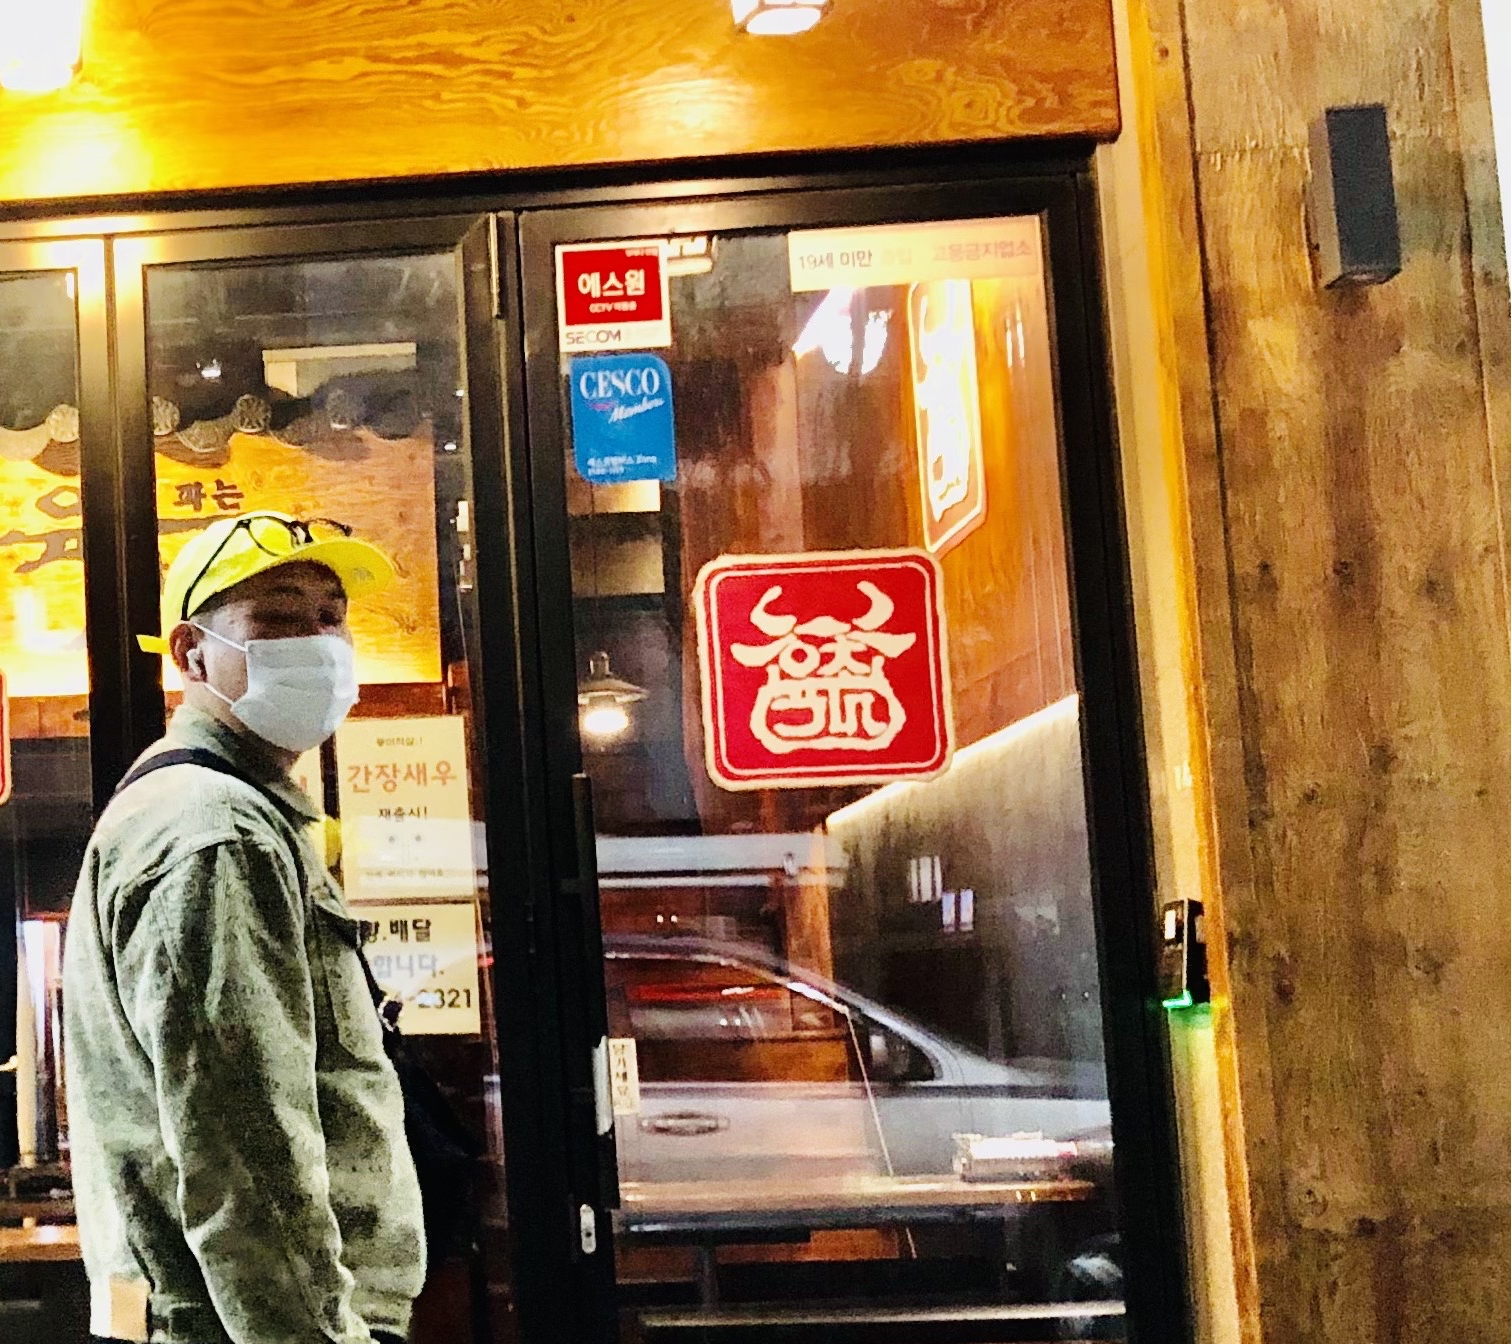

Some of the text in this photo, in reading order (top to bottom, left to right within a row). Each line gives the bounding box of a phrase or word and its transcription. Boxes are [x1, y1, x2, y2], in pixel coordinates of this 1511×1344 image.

[577, 268, 646, 298] 에스원
[565, 329, 621, 344] SECOM
[579, 367, 660, 400] CESCO
[173, 478, 245, 511] 파는
[346, 759, 458, 793] 간장새우
